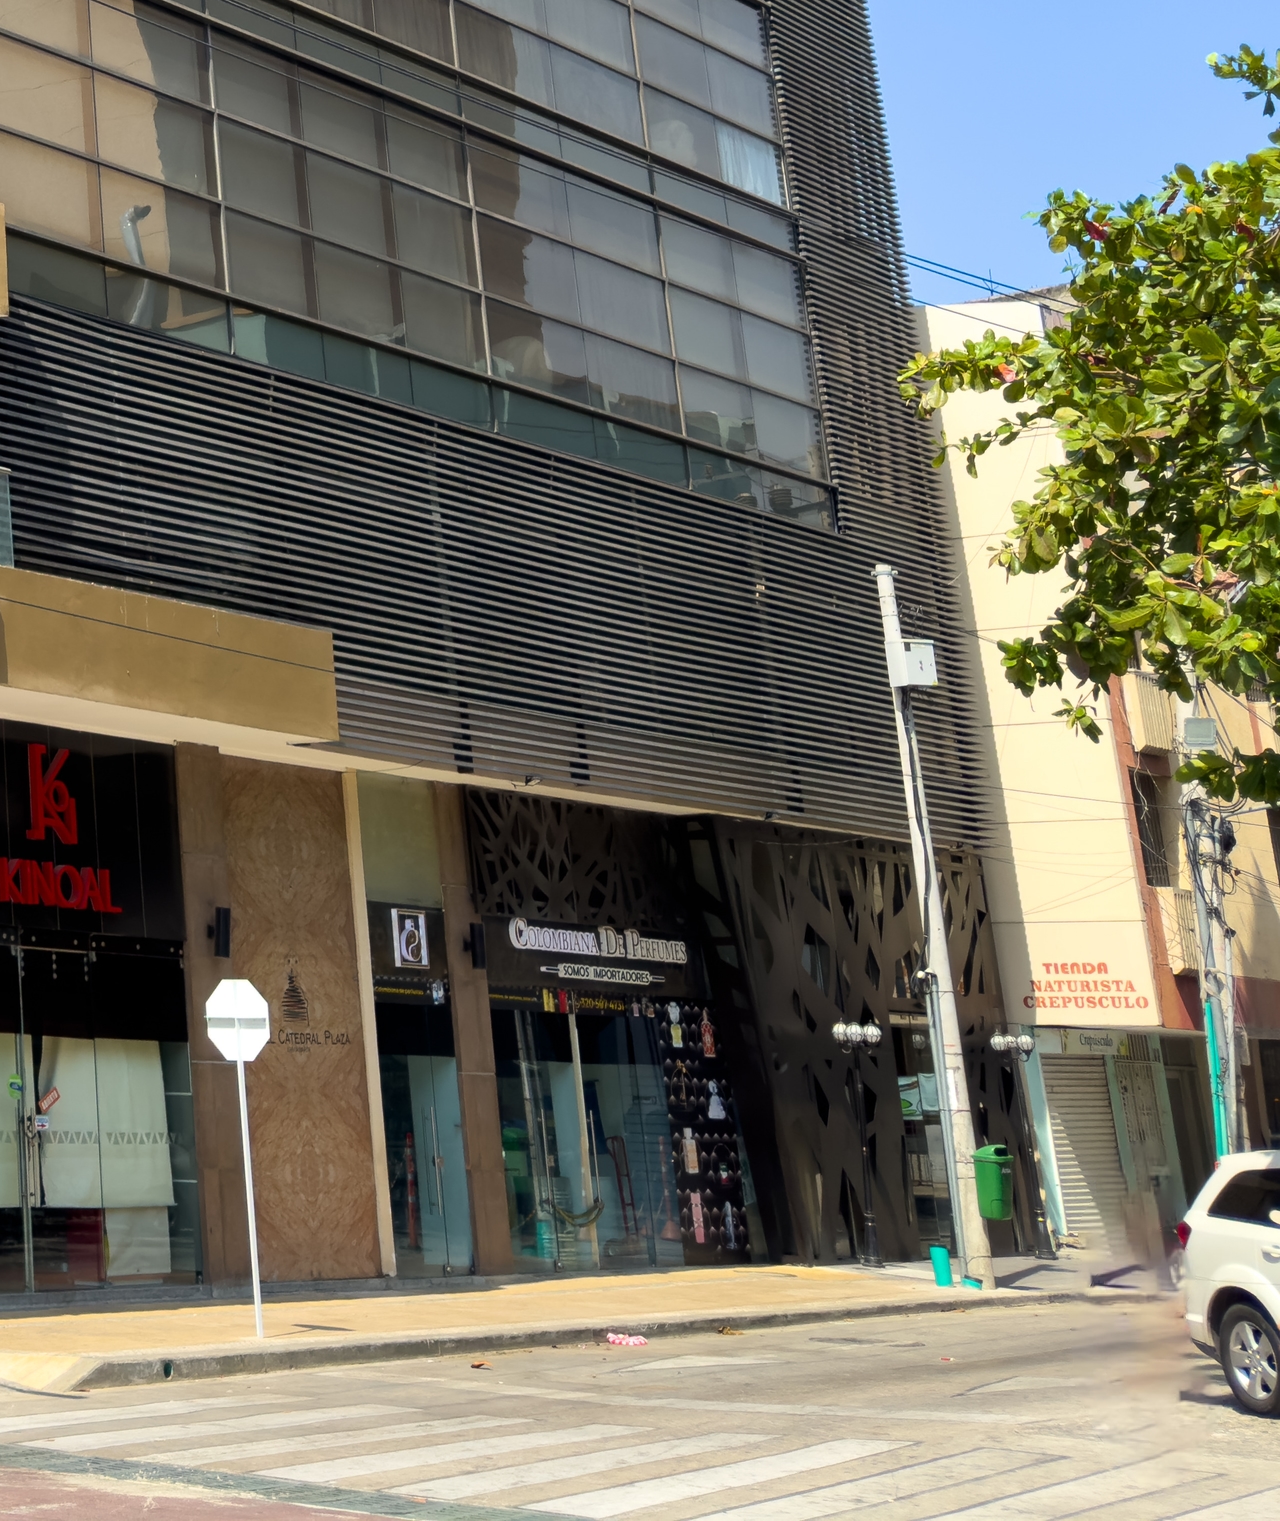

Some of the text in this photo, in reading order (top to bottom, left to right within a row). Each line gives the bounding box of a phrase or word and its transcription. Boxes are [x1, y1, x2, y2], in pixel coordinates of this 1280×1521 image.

[509, 917, 600, 955] COLOMBIANA
[624, 929, 688, 964] PERFUMES
[562, 964, 650, 983] SOMOS IMPORTADORES
[1042, 962, 1109, 975] TIENDA
[1030, 980, 1137, 992] NATURISTA
[1023, 996, 1150, 1009] CREPUSCULO
[278, 1029, 322, 1045] CATEDRAL
[324, 1030, 351, 1045] PLAZA
